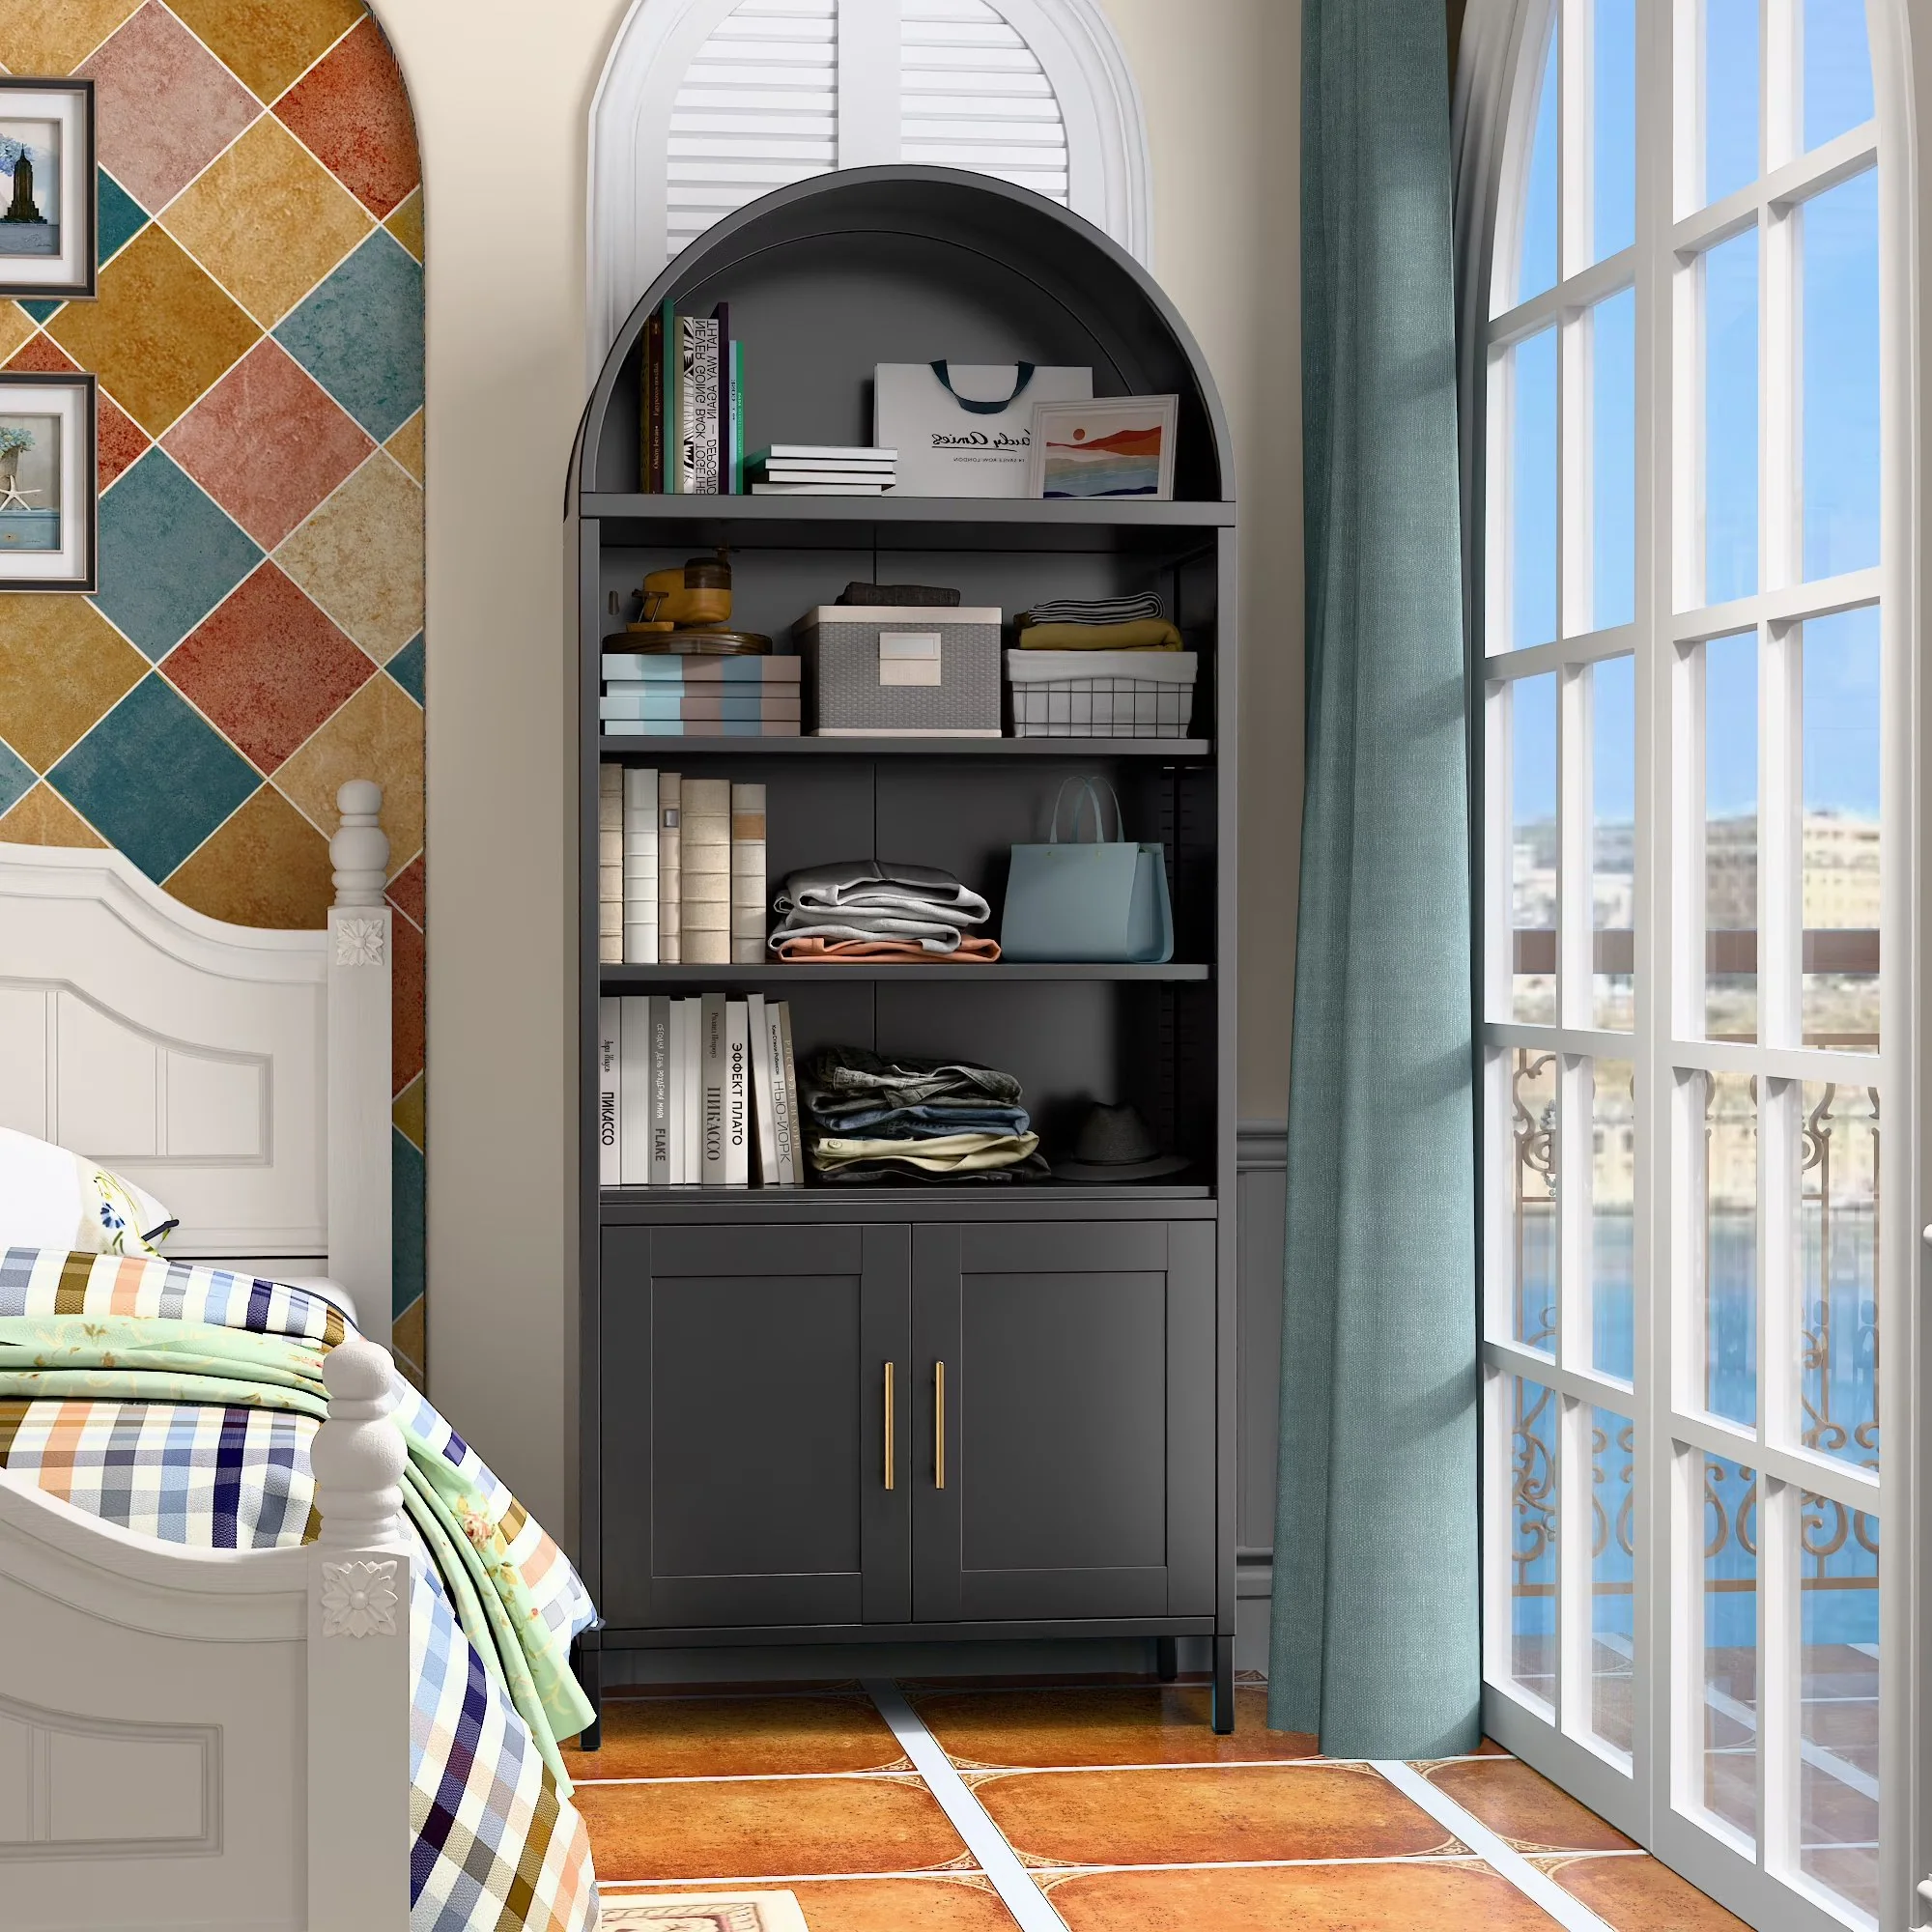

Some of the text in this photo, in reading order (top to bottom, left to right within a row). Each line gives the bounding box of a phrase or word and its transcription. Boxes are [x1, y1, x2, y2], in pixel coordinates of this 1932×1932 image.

[601, 1092, 614, 1146] ПИКАССО
[706, 1087, 722, 1161] ПИКАССО
[731, 1042, 743, 1146] ЭФФЕКТ ПЛАТО
[773, 1080, 791, 1164] НЬЮ-ЙОРК
[655, 1128, 667, 1161] FLAKE
